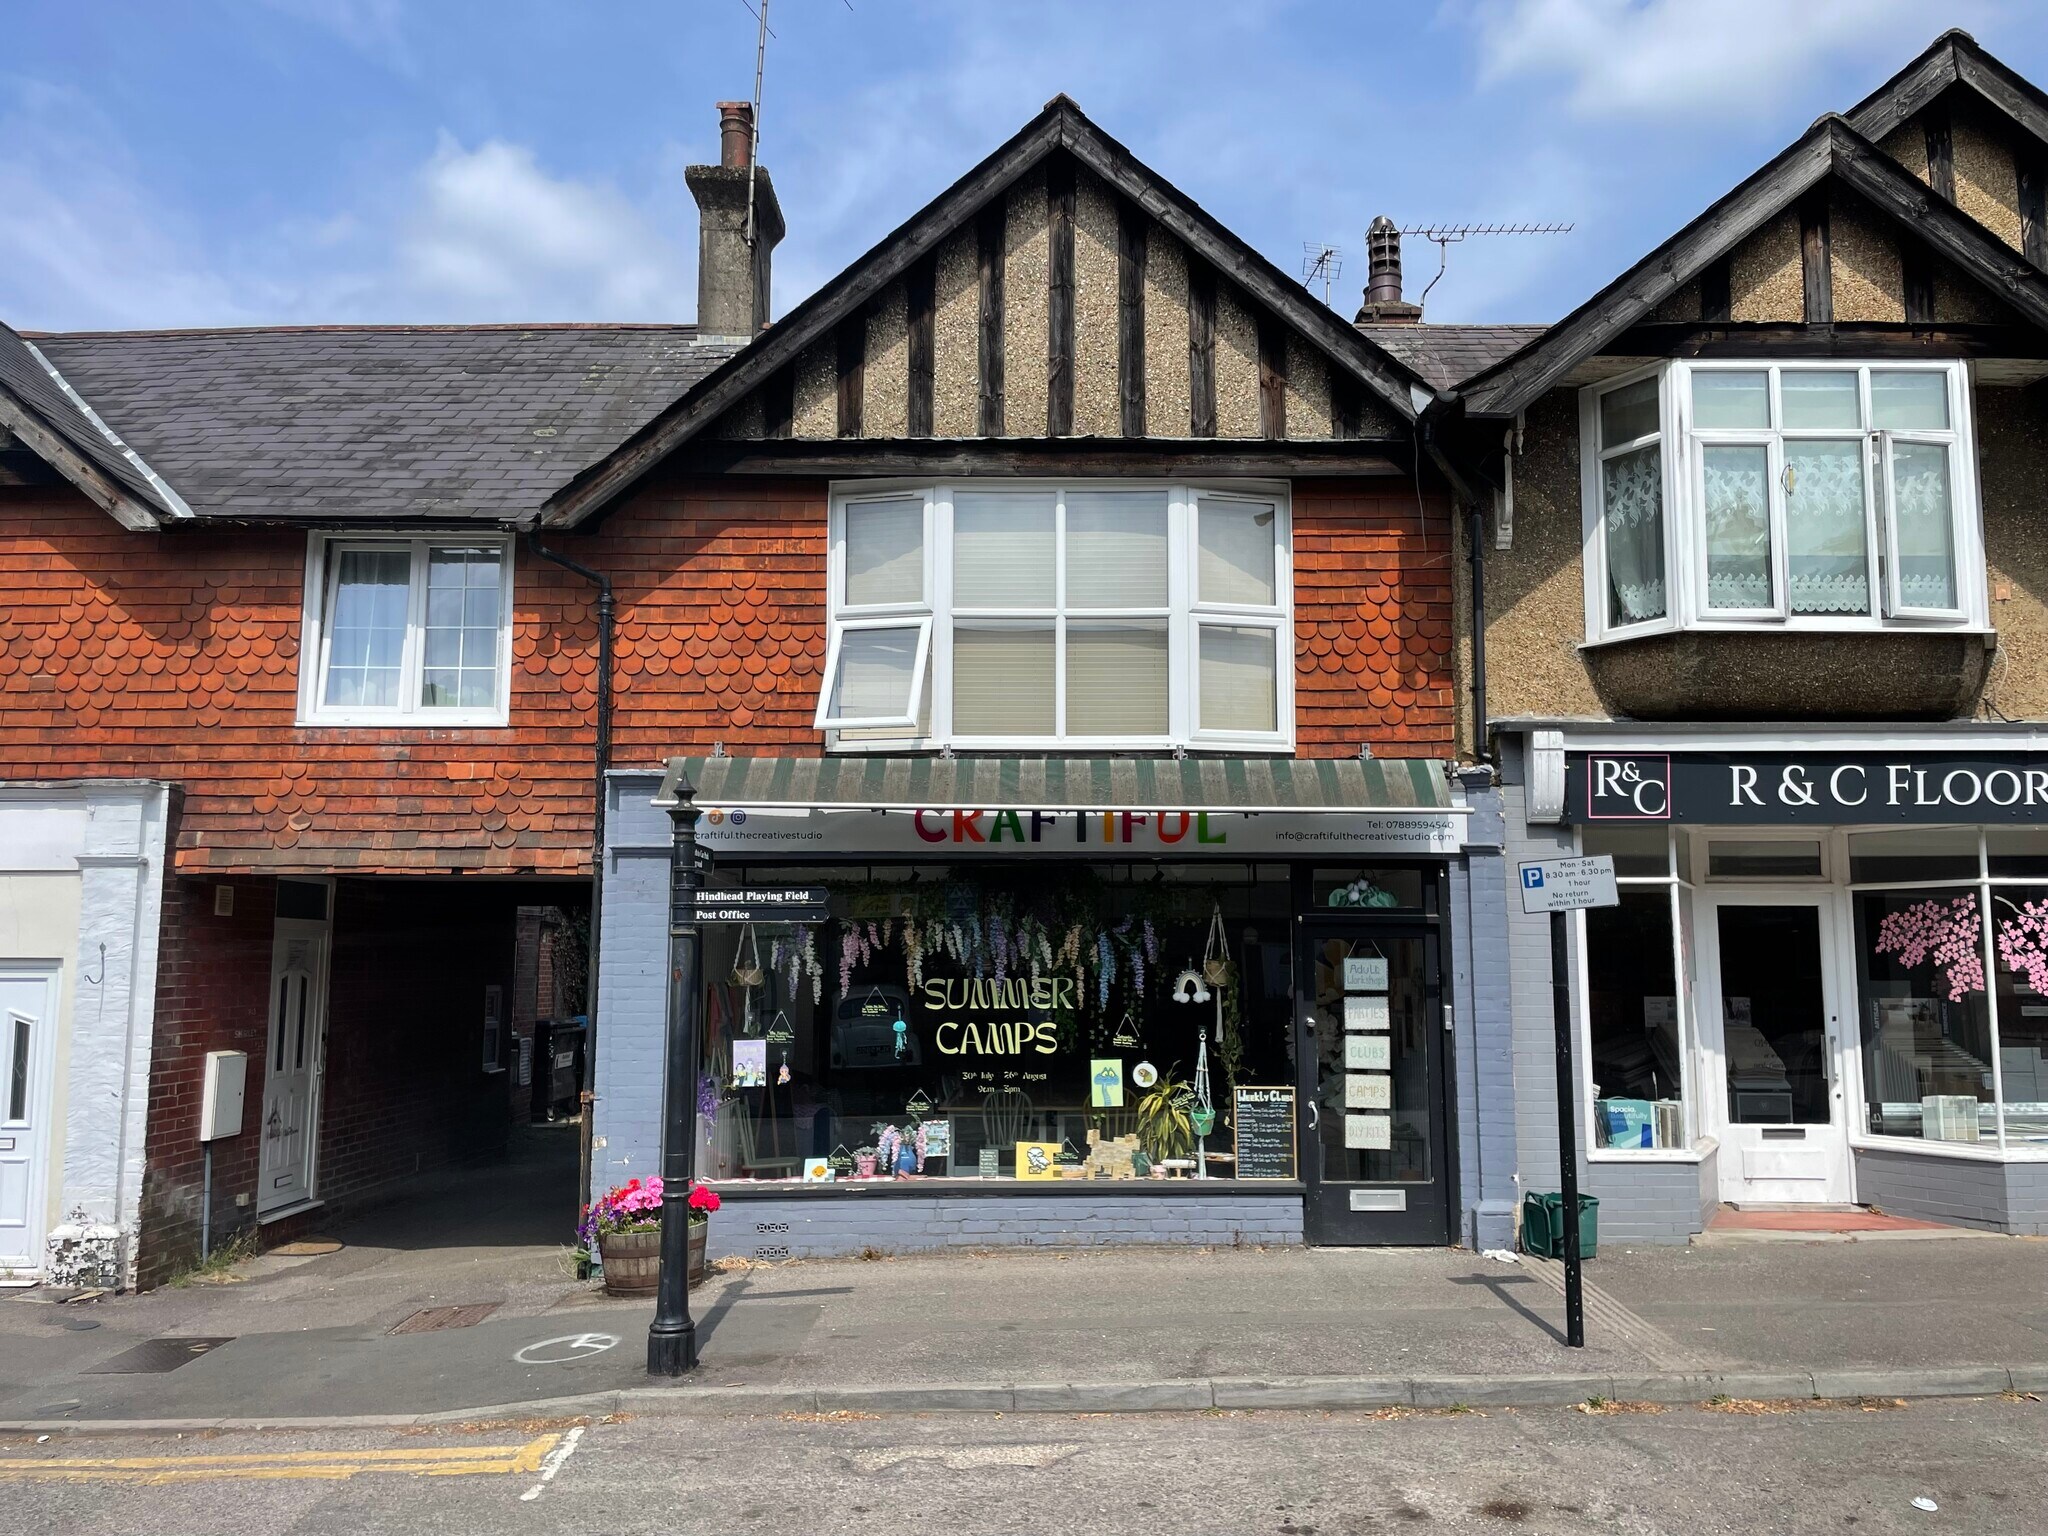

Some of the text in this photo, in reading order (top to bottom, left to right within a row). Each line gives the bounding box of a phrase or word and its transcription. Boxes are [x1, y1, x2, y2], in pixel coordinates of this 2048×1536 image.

[1729, 766, 1766, 806] R
[1777, 765, 1820, 806] &
[1830, 765, 1868, 806] C
[1367, 820, 1384, 829] Tel:
[1560, 861, 1576, 869] Mon
[1545, 871, 1563, 879] 8.30
[1581, 868, 1599, 876] 6.30
[1600, 867, 1612, 875] pm
[696, 891, 809, 902] Hindhead Playing Field
[1548, 899, 1571, 907] within
[696, 910, 750, 919] Post Office
[924, 977, 1074, 1010] SUMMER
[936, 1022, 1058, 1055] CAMPS
[1350, 1045, 1385, 1059] CLUBS
[1349, 1085, 1387, 1098] CAMPS
